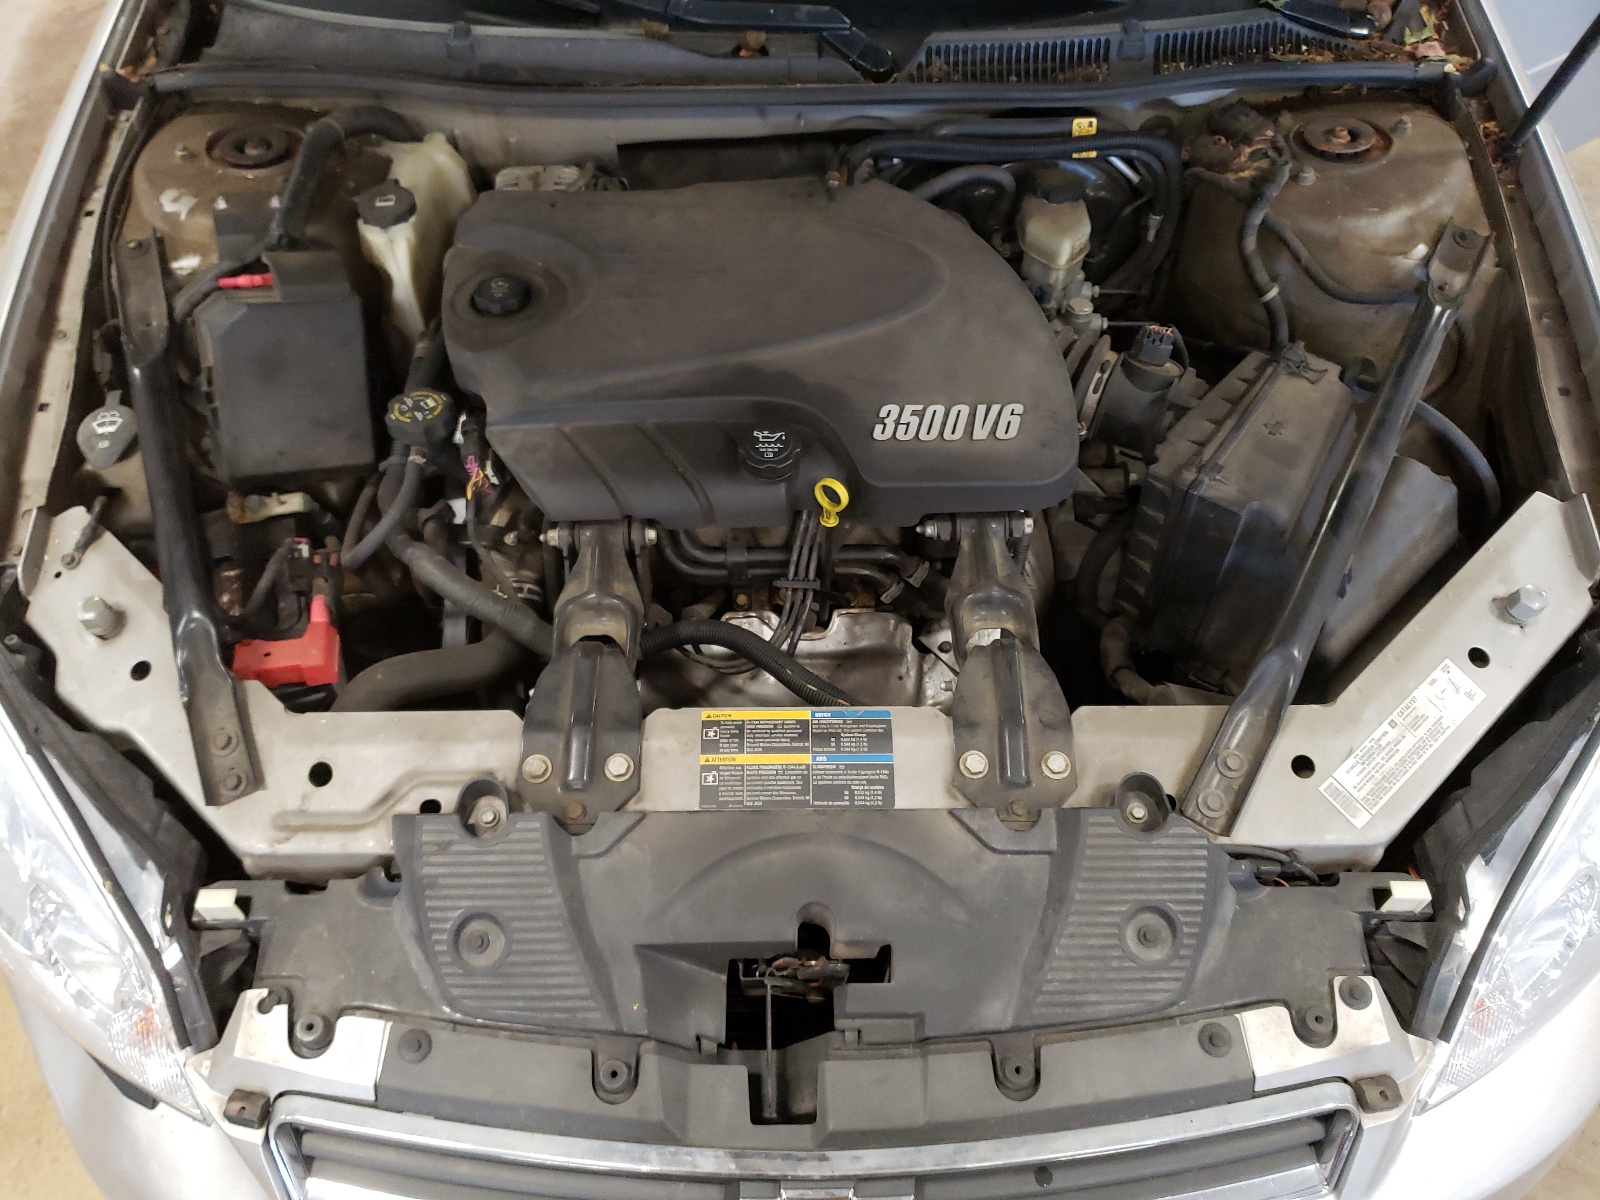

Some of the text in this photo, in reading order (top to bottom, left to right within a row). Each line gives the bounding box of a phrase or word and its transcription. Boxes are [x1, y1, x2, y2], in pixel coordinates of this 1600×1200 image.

[872, 403, 1025, 442] 3500 V6
[1396, 696, 1418, 718] CATALYST
